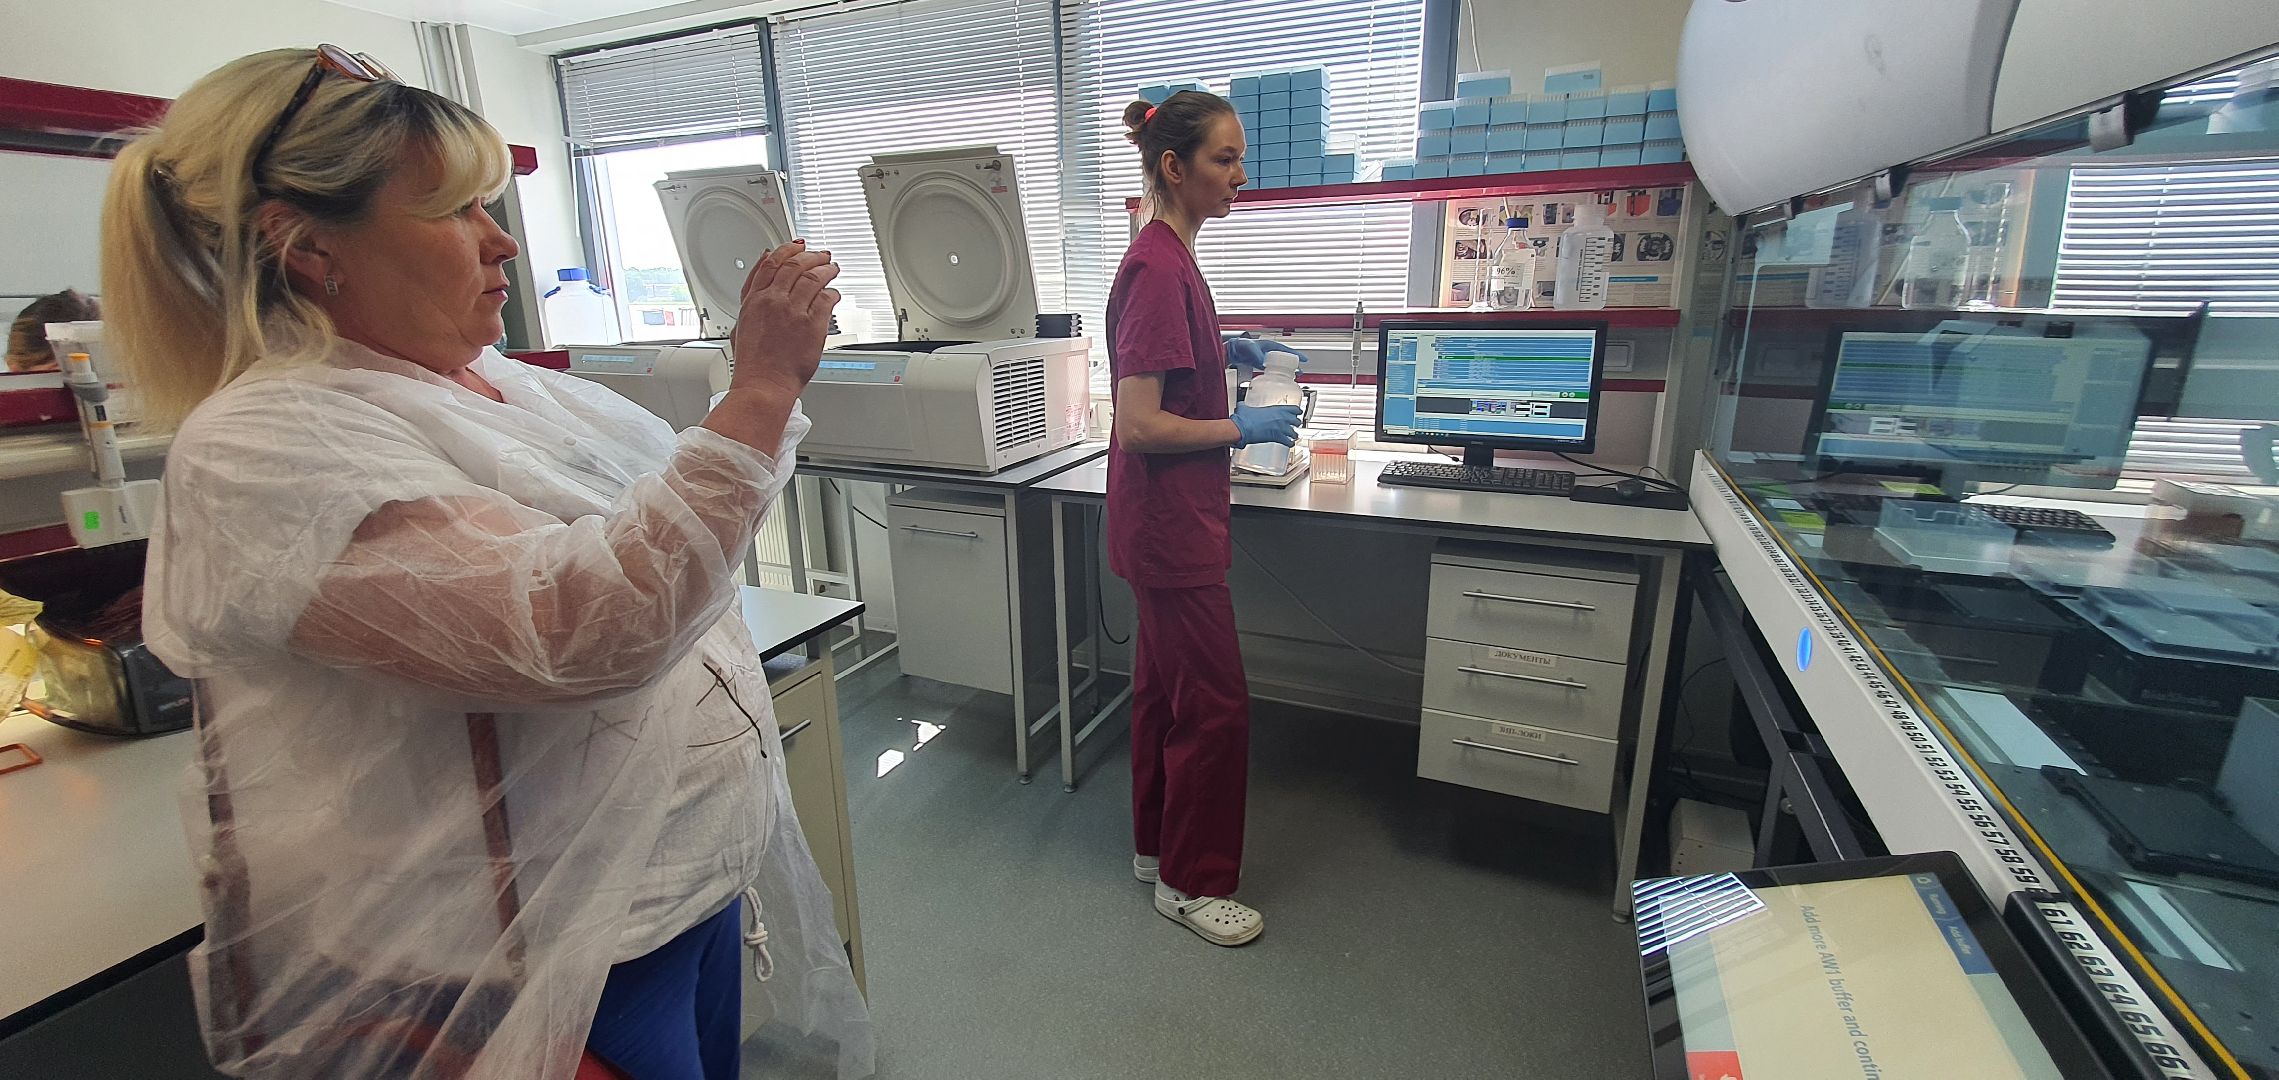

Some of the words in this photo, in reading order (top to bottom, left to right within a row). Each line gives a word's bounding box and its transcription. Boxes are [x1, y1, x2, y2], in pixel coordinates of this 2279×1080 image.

[1496, 267, 1516, 276] 96%
[1494, 650, 1551, 665] ДОКУМЕНТЫ
[1867, 681, 1886, 689] 45
[1874, 690, 1894, 699] 46
[1882, 699, 1901, 708] 47
[1891, 710, 1910, 720] 48
[1899, 720, 1918, 730] 49
[1906, 732, 1928, 741] 50
[1914, 744, 1938, 753] 51
[1924, 757, 1948, 766] 52
[1934, 769, 1959, 781] 53
[1945, 783, 1971, 796] 54
[1956, 798, 1983, 811] 55
[1968, 814, 1997, 828] 56
[1980, 830, 2010, 846] 57
[1994, 848, 2024, 864] 58
[2008, 867, 2040, 884] 59
[1801, 905, 1822, 924] Add
[2041, 908, 2075, 926] 61
[1807, 924, 1828, 950] more
[2057, 931, 2094, 951] 62
[1818, 951, 1842, 975] AW1
[2076, 956, 2115, 977] 63
[1828, 978, 1854, 1013] buffer
[2097, 982, 2139, 1006] 64
[1843, 1015, 1868, 1037] and
[2119, 1011, 2165, 1037] 65
[2144, 1042, 2191, 1070] 66
